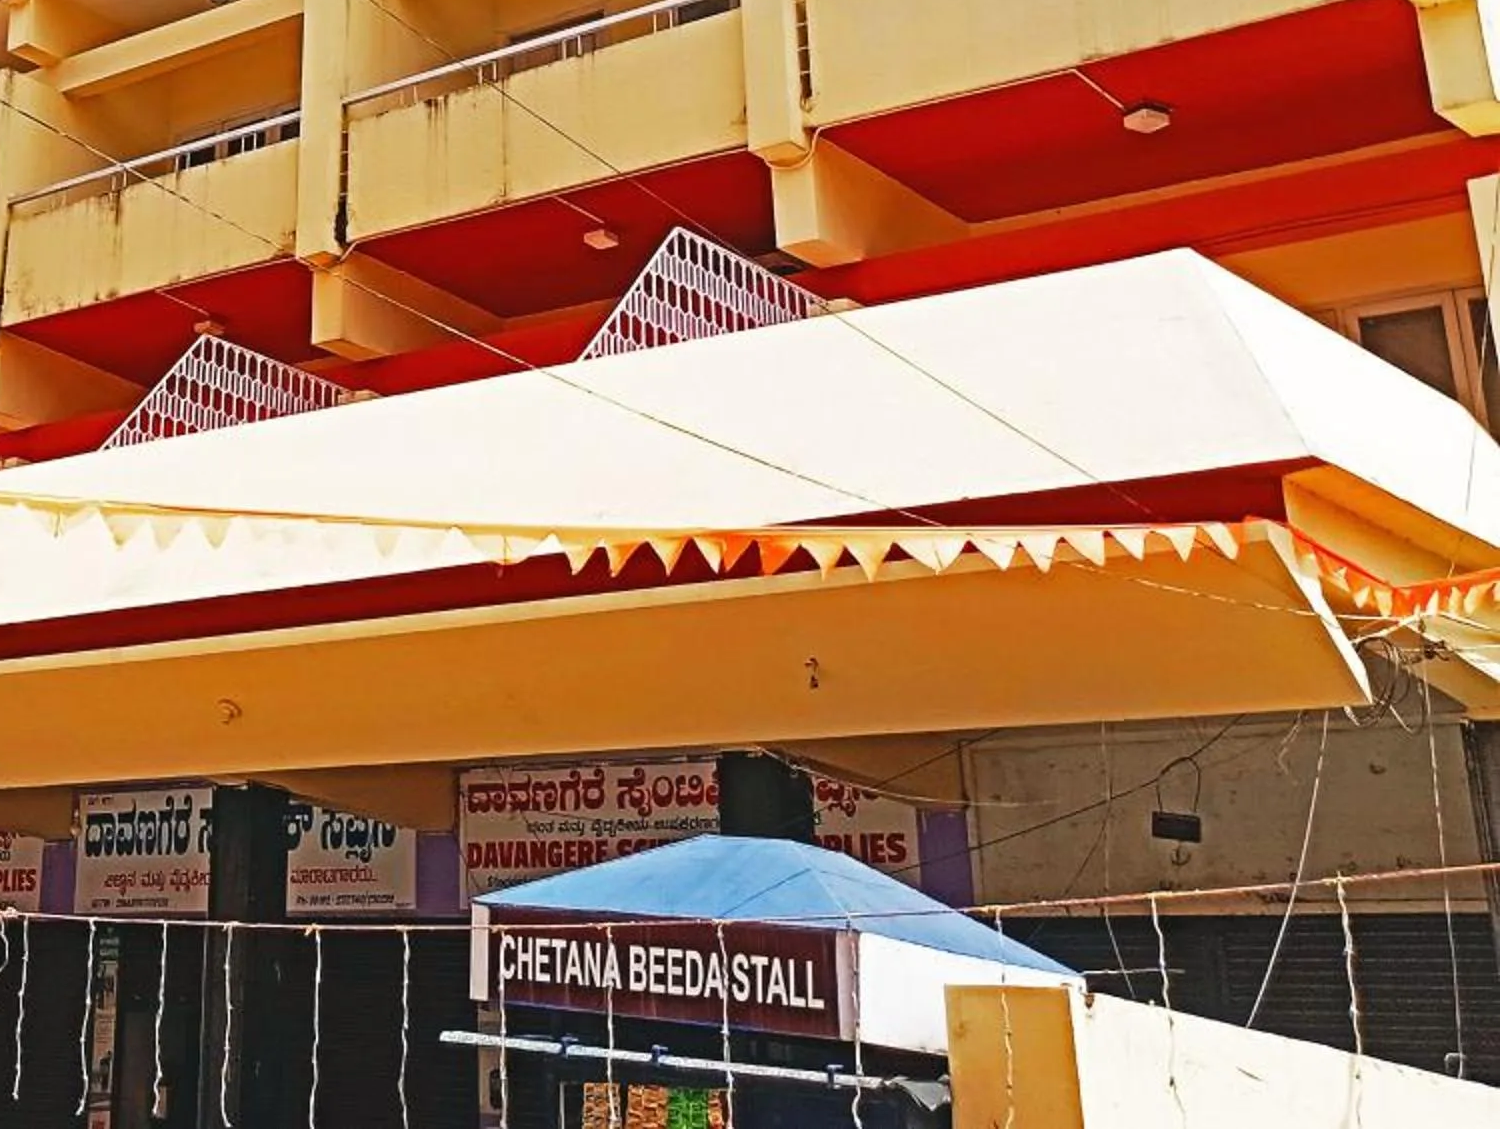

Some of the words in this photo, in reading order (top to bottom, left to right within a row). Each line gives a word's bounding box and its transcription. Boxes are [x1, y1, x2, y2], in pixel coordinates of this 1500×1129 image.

[501, 933, 623, 991] CHETANA
[629, 944, 725, 1000] BEEDA
[732, 952, 826, 1010] STALL
